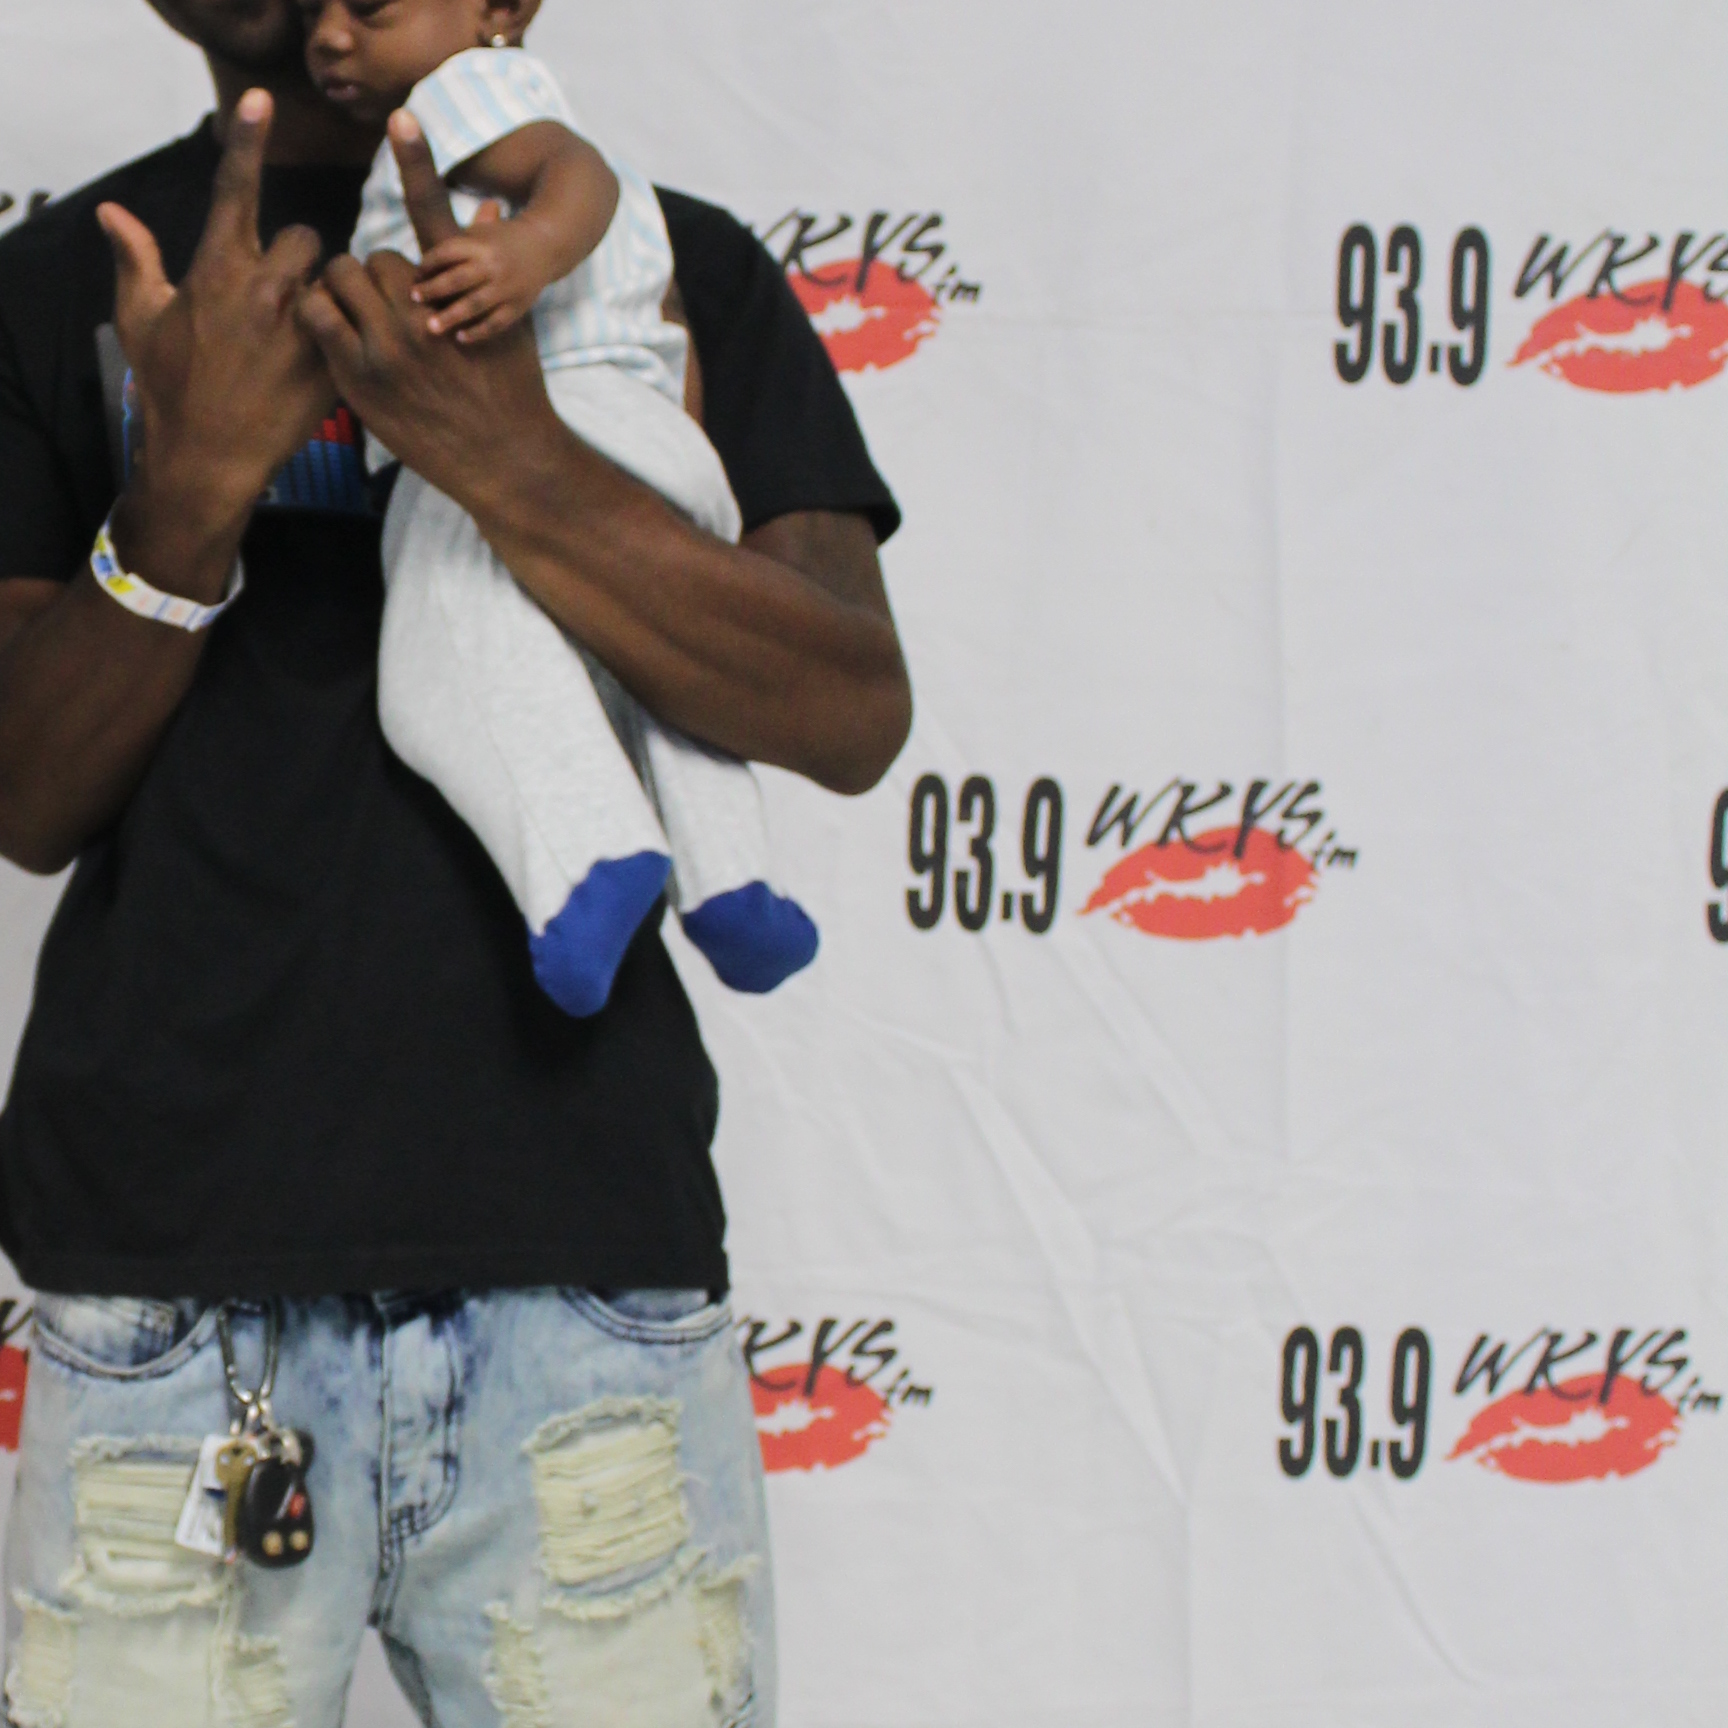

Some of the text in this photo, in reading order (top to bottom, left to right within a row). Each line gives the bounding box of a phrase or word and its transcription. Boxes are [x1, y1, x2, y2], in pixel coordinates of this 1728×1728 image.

[750, 207, 947, 293] KYS
[1335, 223, 1491, 386] 93.9
[907, 773, 1064, 935] 93.9
[1087, 780, 1323, 859] WKYS
[734, 1315, 897, 1397] KYS
[1279, 1326, 1433, 1480] 93.9
[1455, 1327, 1688, 1404] WKYS
